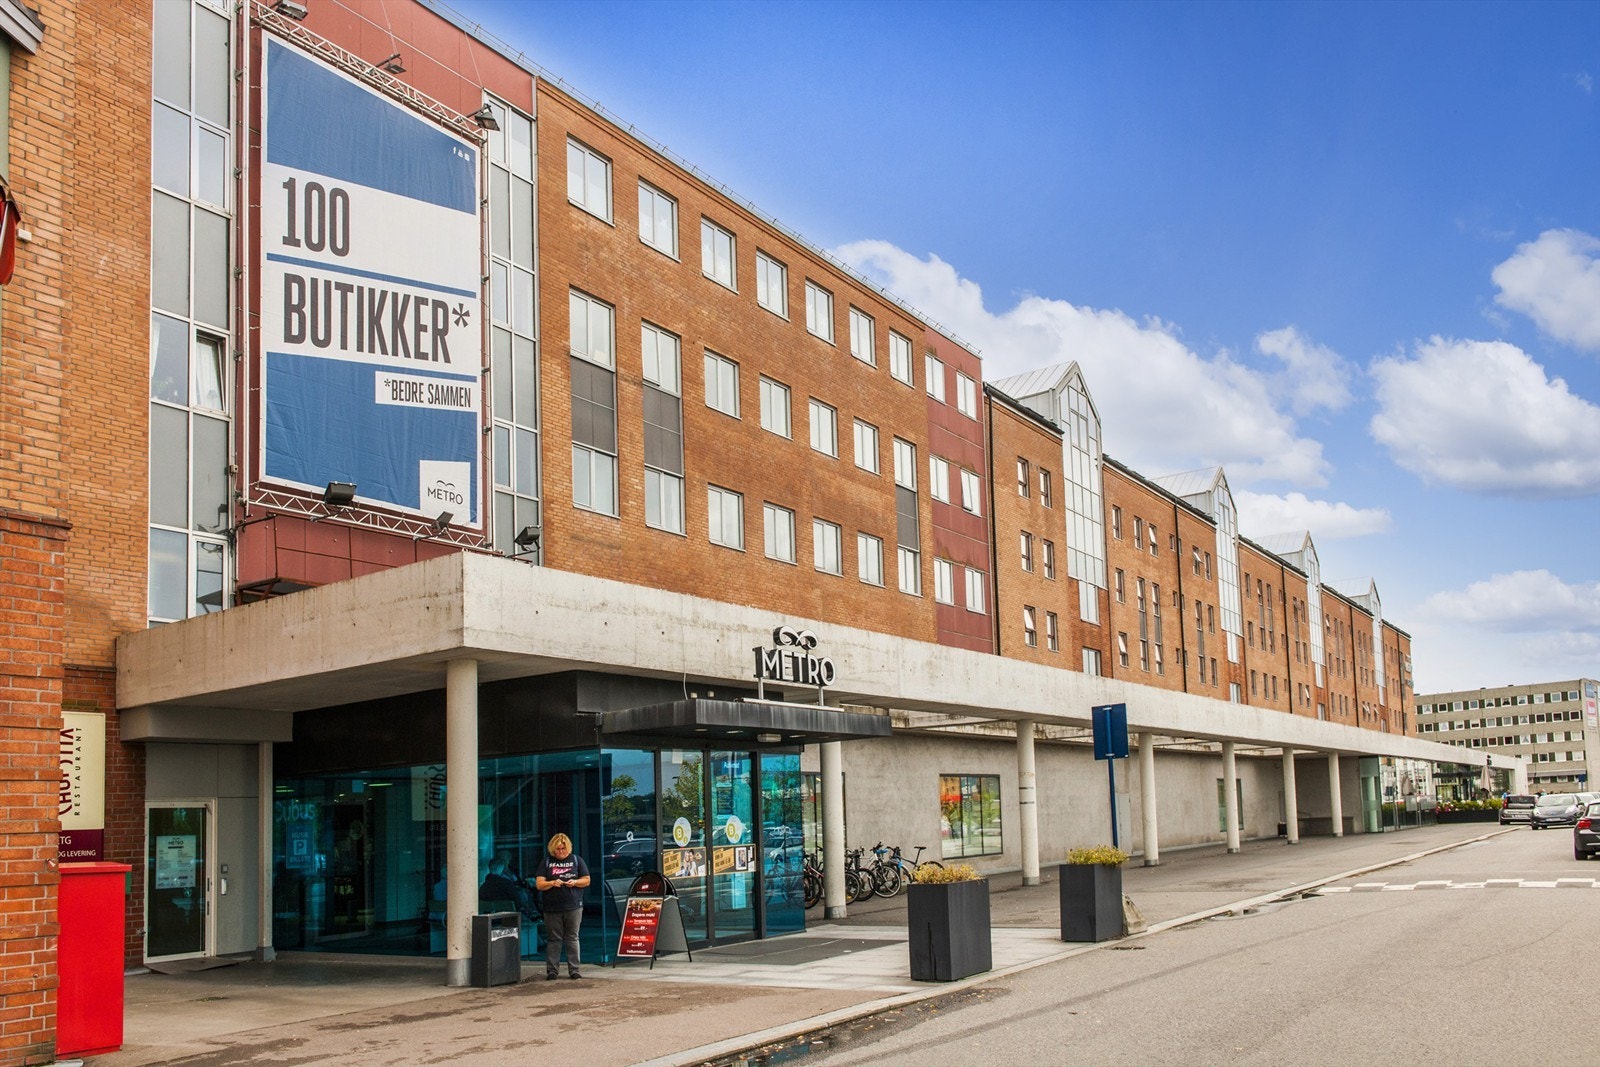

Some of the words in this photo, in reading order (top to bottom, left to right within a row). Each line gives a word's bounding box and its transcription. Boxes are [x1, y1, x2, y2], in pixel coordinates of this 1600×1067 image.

[282, 177, 350, 257] 100
[427, 385, 471, 408] SAMMEN
[427, 486, 464, 505] METRO
[753, 646, 836, 686] METRO
[74, 727, 82, 816] RESTAURANT
[58, 836, 72, 845] TG
[66, 849, 96, 857] LEVERING
